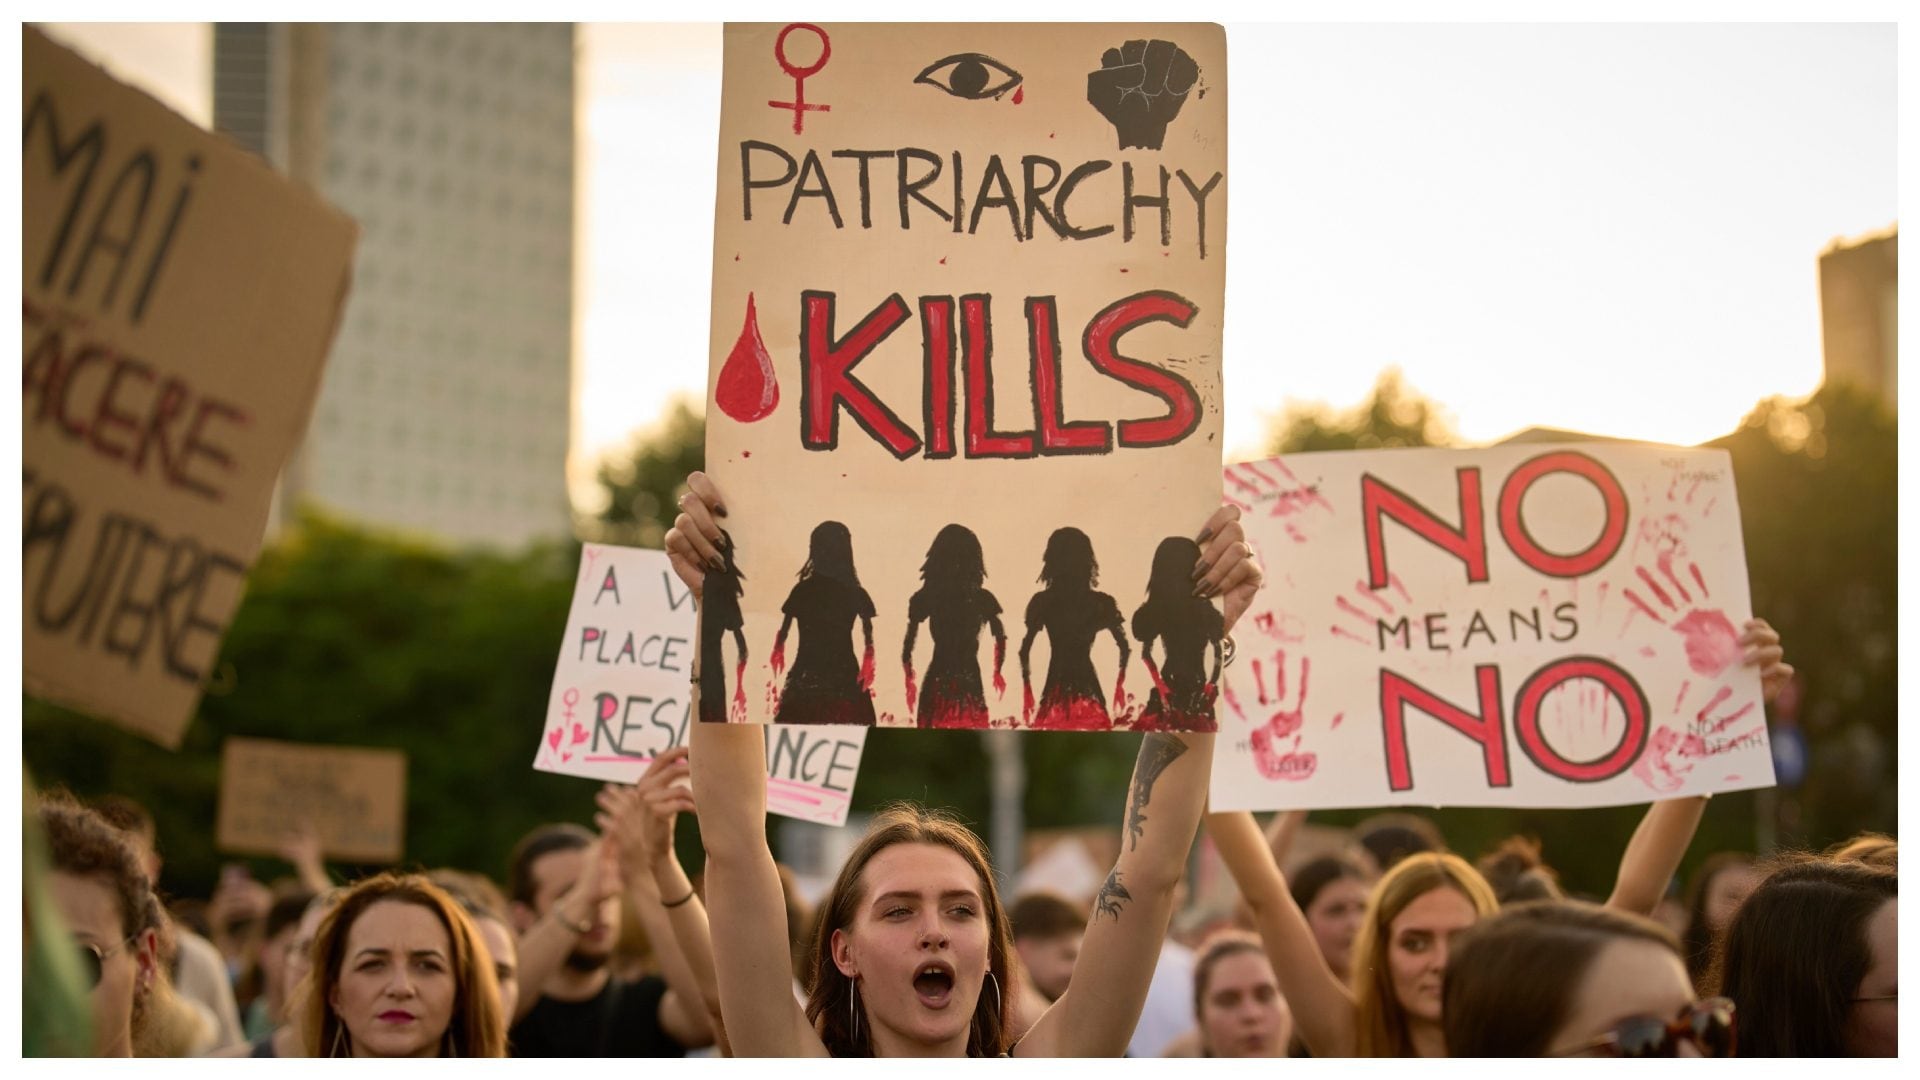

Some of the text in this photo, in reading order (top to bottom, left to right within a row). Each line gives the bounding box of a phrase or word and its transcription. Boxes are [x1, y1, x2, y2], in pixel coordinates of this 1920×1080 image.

[740, 141, 1223, 260] PATRIARCHY
[800, 289, 1204, 461] KILLS
[1361, 450, 1630, 590] NO
[594, 565, 621, 607] A
[1377, 602, 1580, 652] MEANS
[579, 626, 688, 672] PLACE
[1380, 655, 1651, 791] NO
